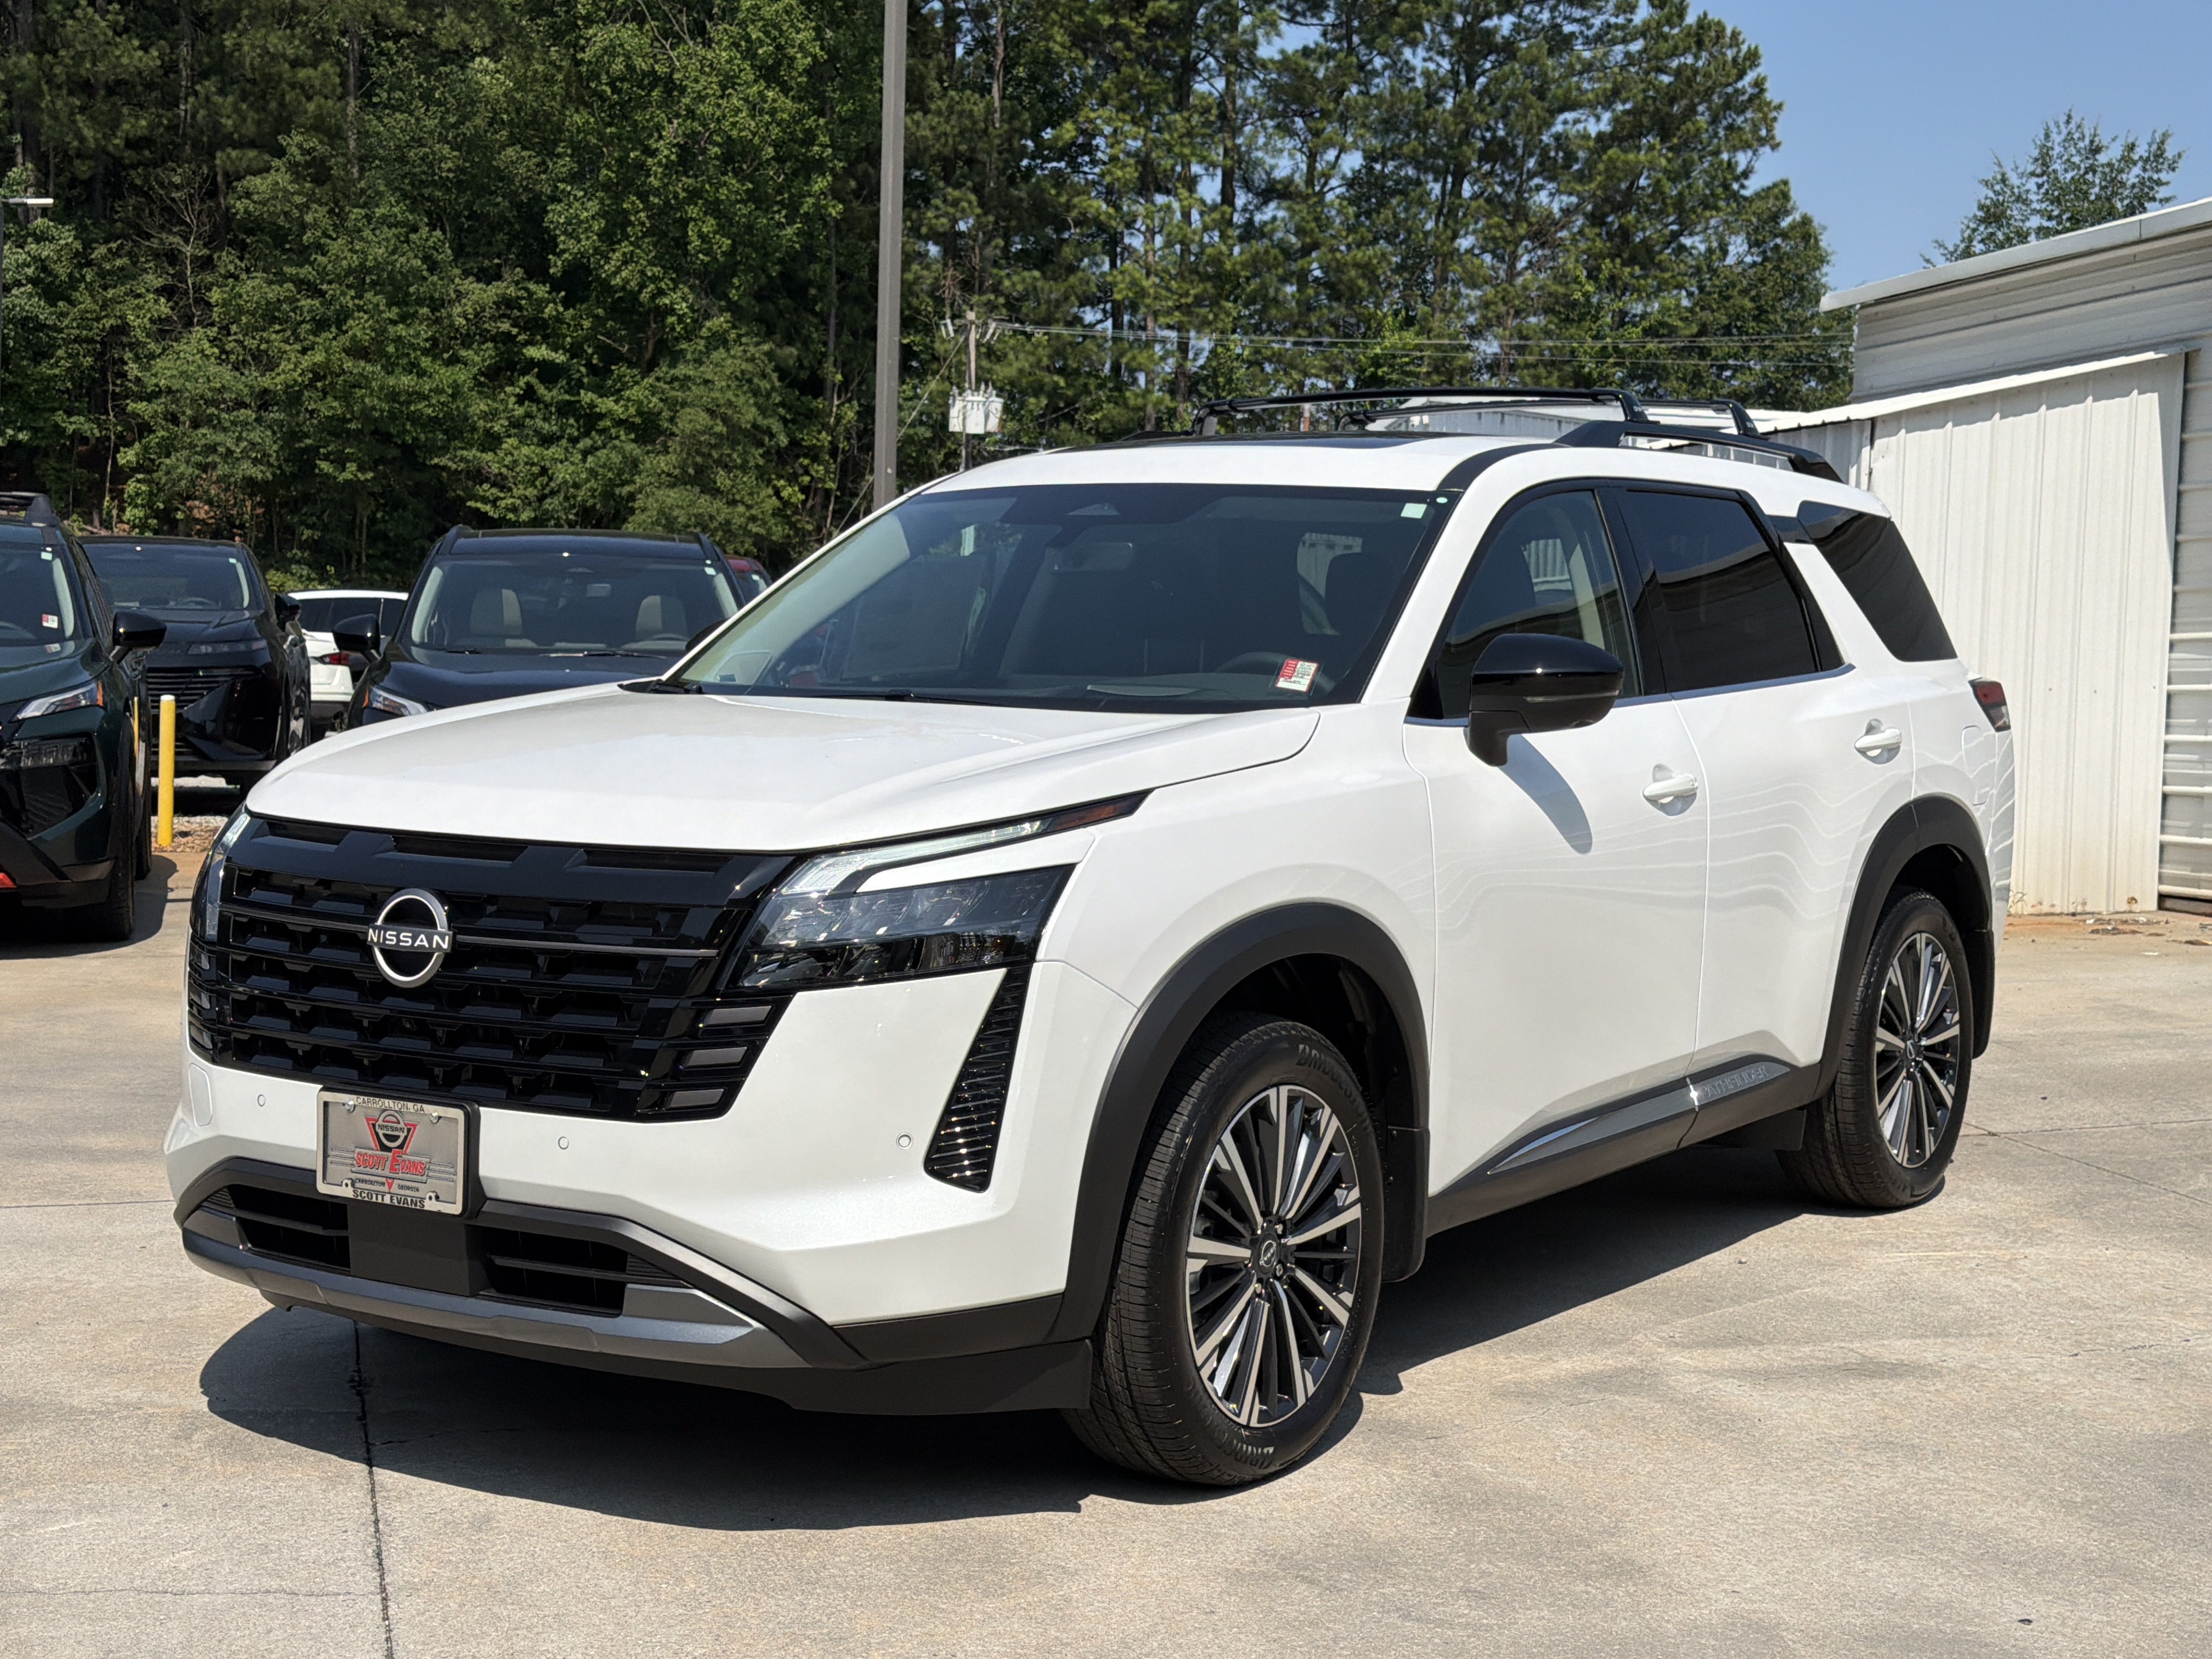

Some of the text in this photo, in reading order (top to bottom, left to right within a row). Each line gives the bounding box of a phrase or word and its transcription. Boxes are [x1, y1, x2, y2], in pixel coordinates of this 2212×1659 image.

[367, 928, 449, 949] NISSAN
[413, 1104, 425, 1113] GA
[377, 1124, 405, 1134] NISSAN
[356, 1152, 388, 1170] SCOTT
[352, 1189, 425, 1209] SCOTT EVANS
